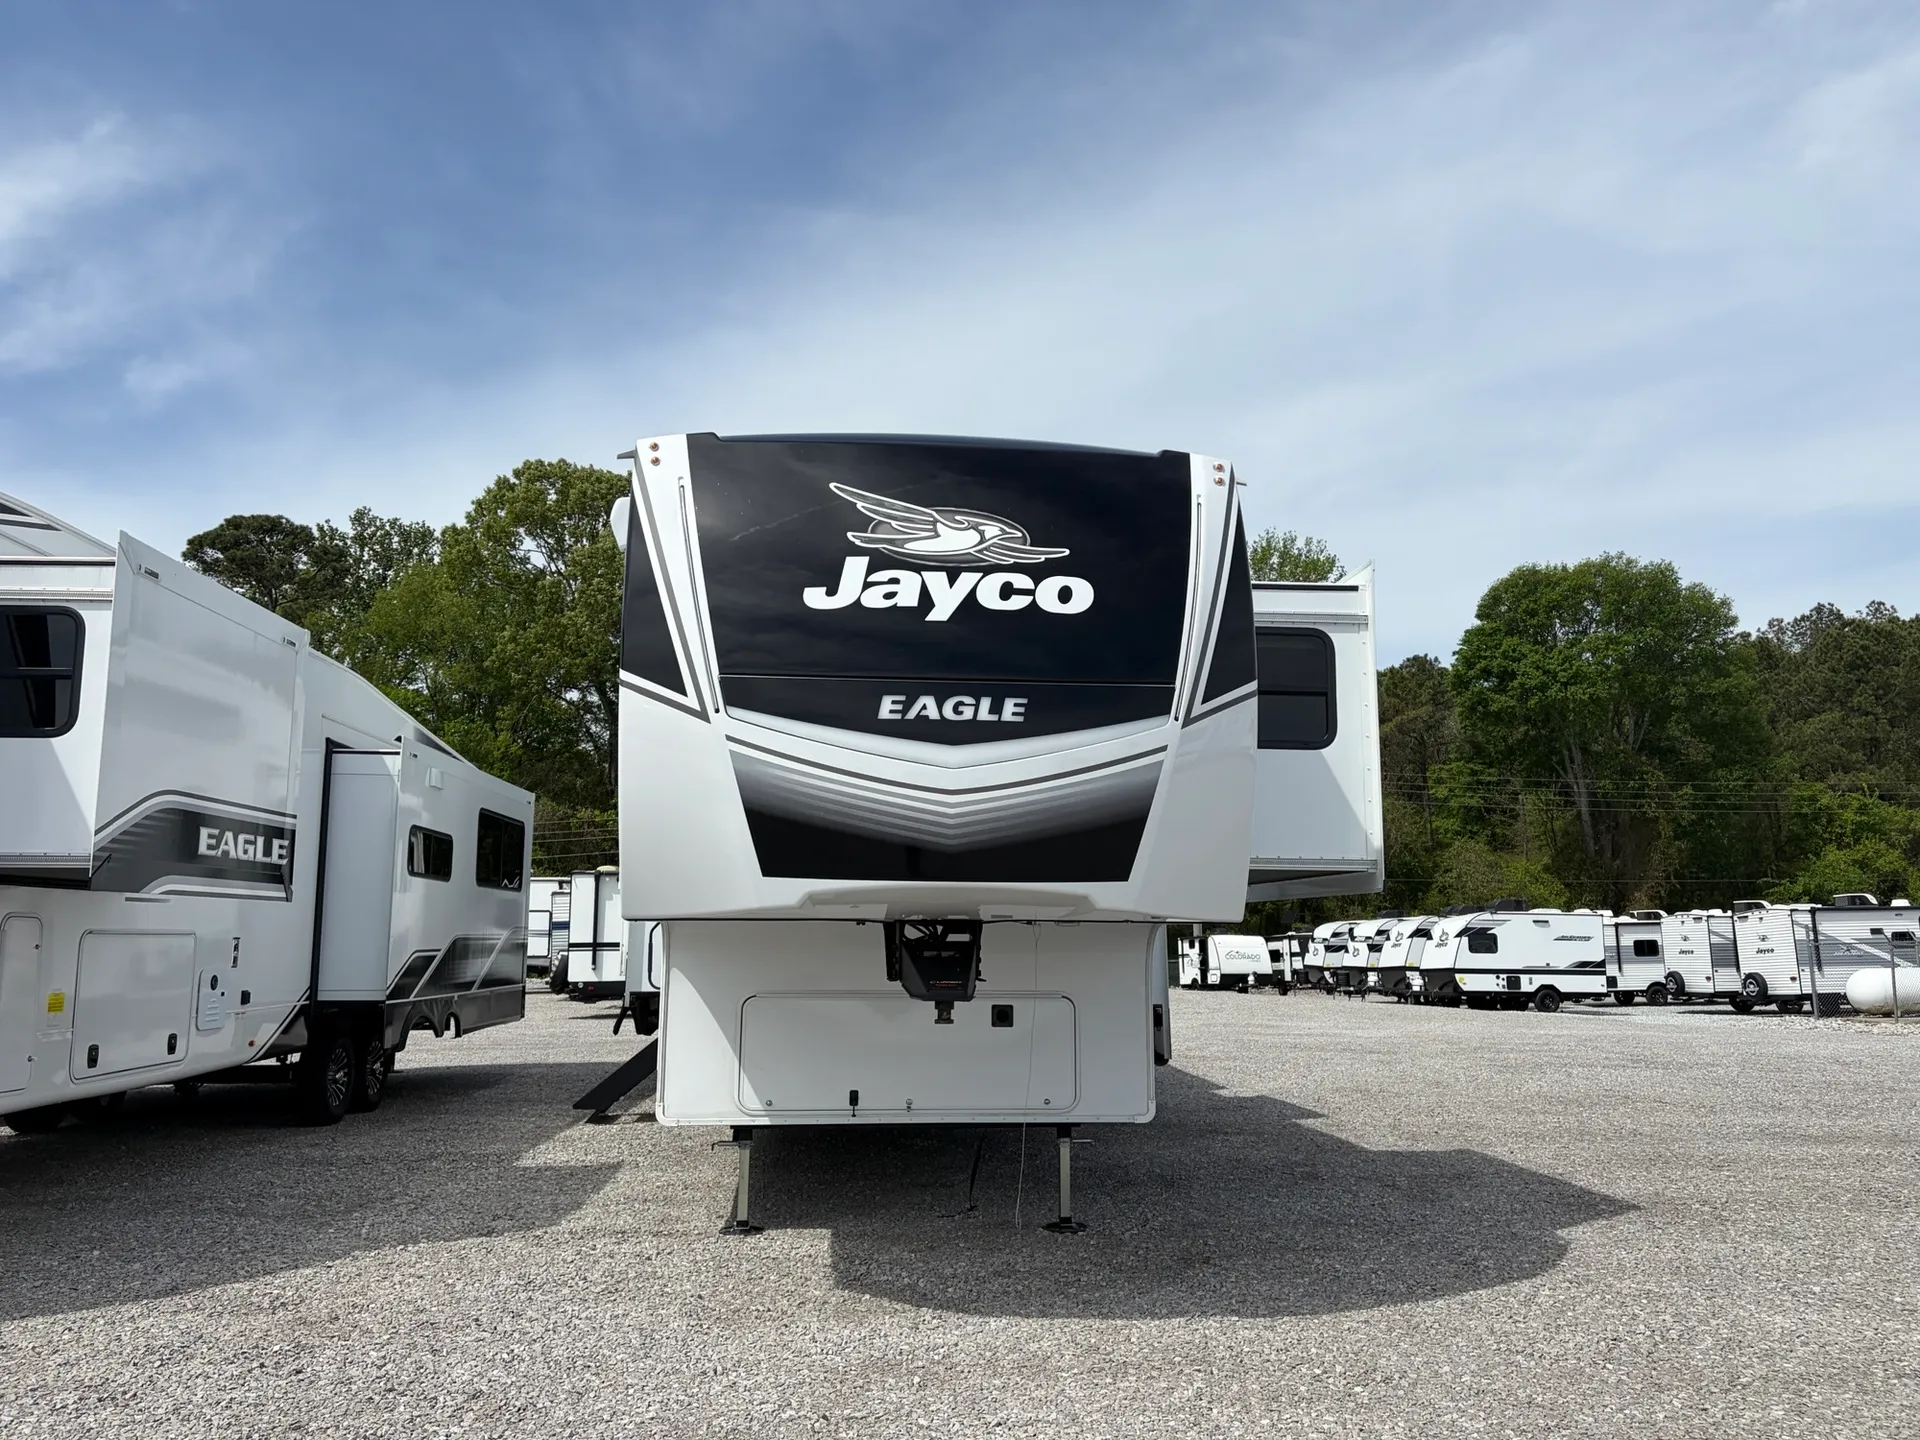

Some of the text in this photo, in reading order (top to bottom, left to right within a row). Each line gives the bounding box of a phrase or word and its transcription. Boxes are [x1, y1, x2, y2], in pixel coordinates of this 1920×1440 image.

[803, 556, 1094, 621] Jayco
[877, 695, 1028, 722] EAGLE
[197, 826, 290, 865] EAGLE
[1225, 950, 1261, 960] COLORADO
